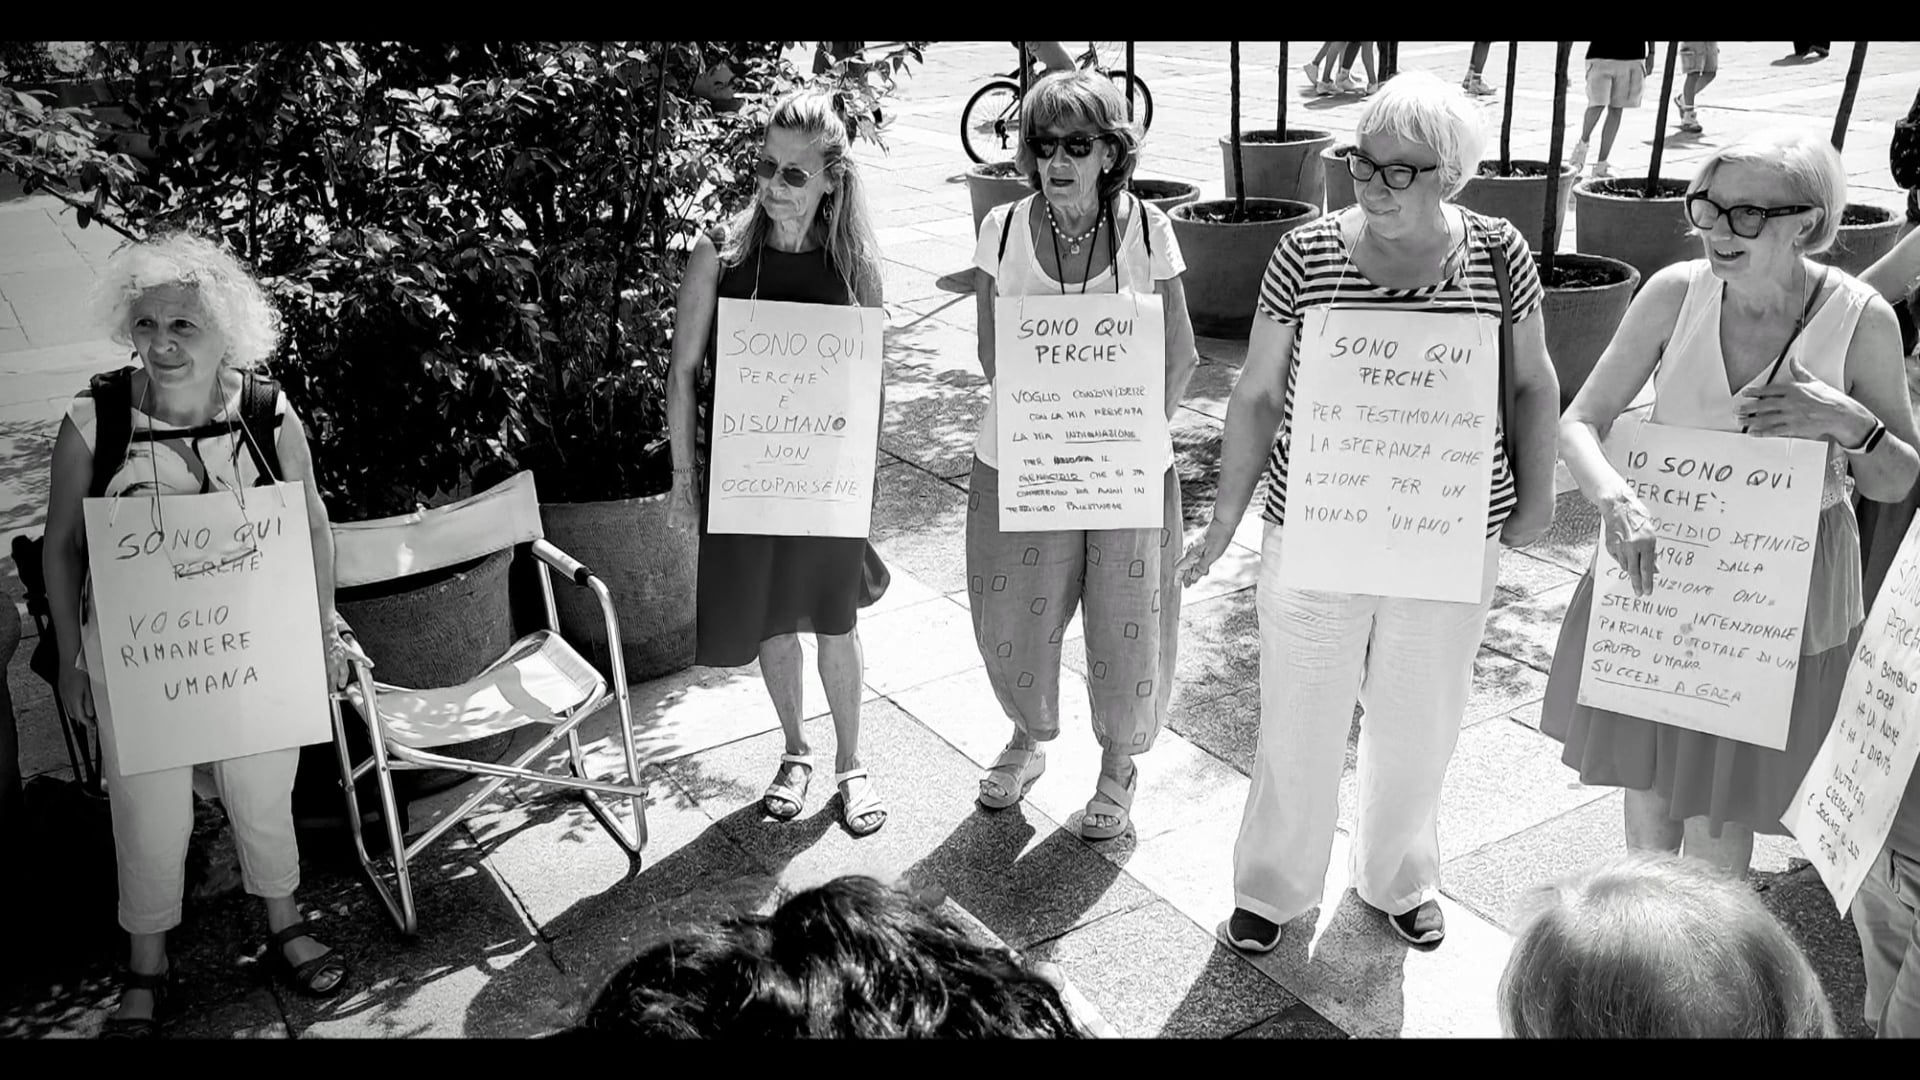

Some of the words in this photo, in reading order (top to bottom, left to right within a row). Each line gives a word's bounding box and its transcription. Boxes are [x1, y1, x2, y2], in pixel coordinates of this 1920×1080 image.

[1018, 318, 1079, 340] SONO
[1094, 317, 1134, 338] QUI
[726, 329, 808, 357] SONO
[1330, 337, 1399, 360] SONO
[1424, 343, 1473, 365] QUI
[1011, 389, 1062, 404] VOGLIO
[722, 413, 847, 434] DISUMANO
[1029, 412, 1048, 421] CON
[1051, 412, 1063, 420] LA
[1066, 411, 1086, 419] MIA
[1312, 402, 1342, 422] PER
[1356, 404, 1486, 429] TESTIMONIARE
[1012, 432, 1028, 442] LA
[1033, 432, 1053, 441] MIA
[1310, 434, 1329, 453] LA
[1340, 436, 1431, 460] SPERANZA
[1441, 449, 1484, 466] COME
[764, 444, 810, 461] NON
[1023, 457, 1045, 467] PER
[1101, 455, 1111, 463] IL
[1090, 471, 1107, 479] CHE
[1115, 469, 1124, 477] SI
[1627, 451, 1648, 469] IO
[1658, 457, 1733, 482] SONO
[721, 477, 859, 497] OCCUPARSENE
[1098, 487, 1122, 495] ANNI
[1134, 487, 1145, 495] IN
[1305, 473, 1370, 488] AZIONE
[1391, 476, 1422, 495] PER
[1442, 484, 1466, 498] UN
[1305, 505, 1369, 523] MONDO
[116, 528, 211, 561] SONO
[233, 516, 282, 544] QUI
[1650, 517, 1721, 542] OCIDIO
[1730, 531, 1810, 553] DEFINITO
[1717, 559, 1763, 575] DALLA
[129, 605, 230, 640] VOGLIO
[1601, 593, 1679, 618] STERMINIO
[1693, 612, 1799, 641] INTENZIONALE
[121, 631, 251, 668] RIMANERE
[1592, 639, 1641, 658] GRUPPO
[1599, 615, 1664, 641] PARZIALE
[1673, 634, 1683, 646] O
[1690, 637, 1750, 658] TOTALE
[1756, 650, 1771, 664] DI
[1776, 656, 1797, 671] UN
[164, 666, 259, 701] UMANA
[1591, 659, 1660, 685] SUCCEDE
[1674, 681, 1685, 693] A
[1696, 683, 1742, 702] GAZA
[1880, 660, 1917, 694] BAMBINO
[1880, 718, 1899, 746] NOME
